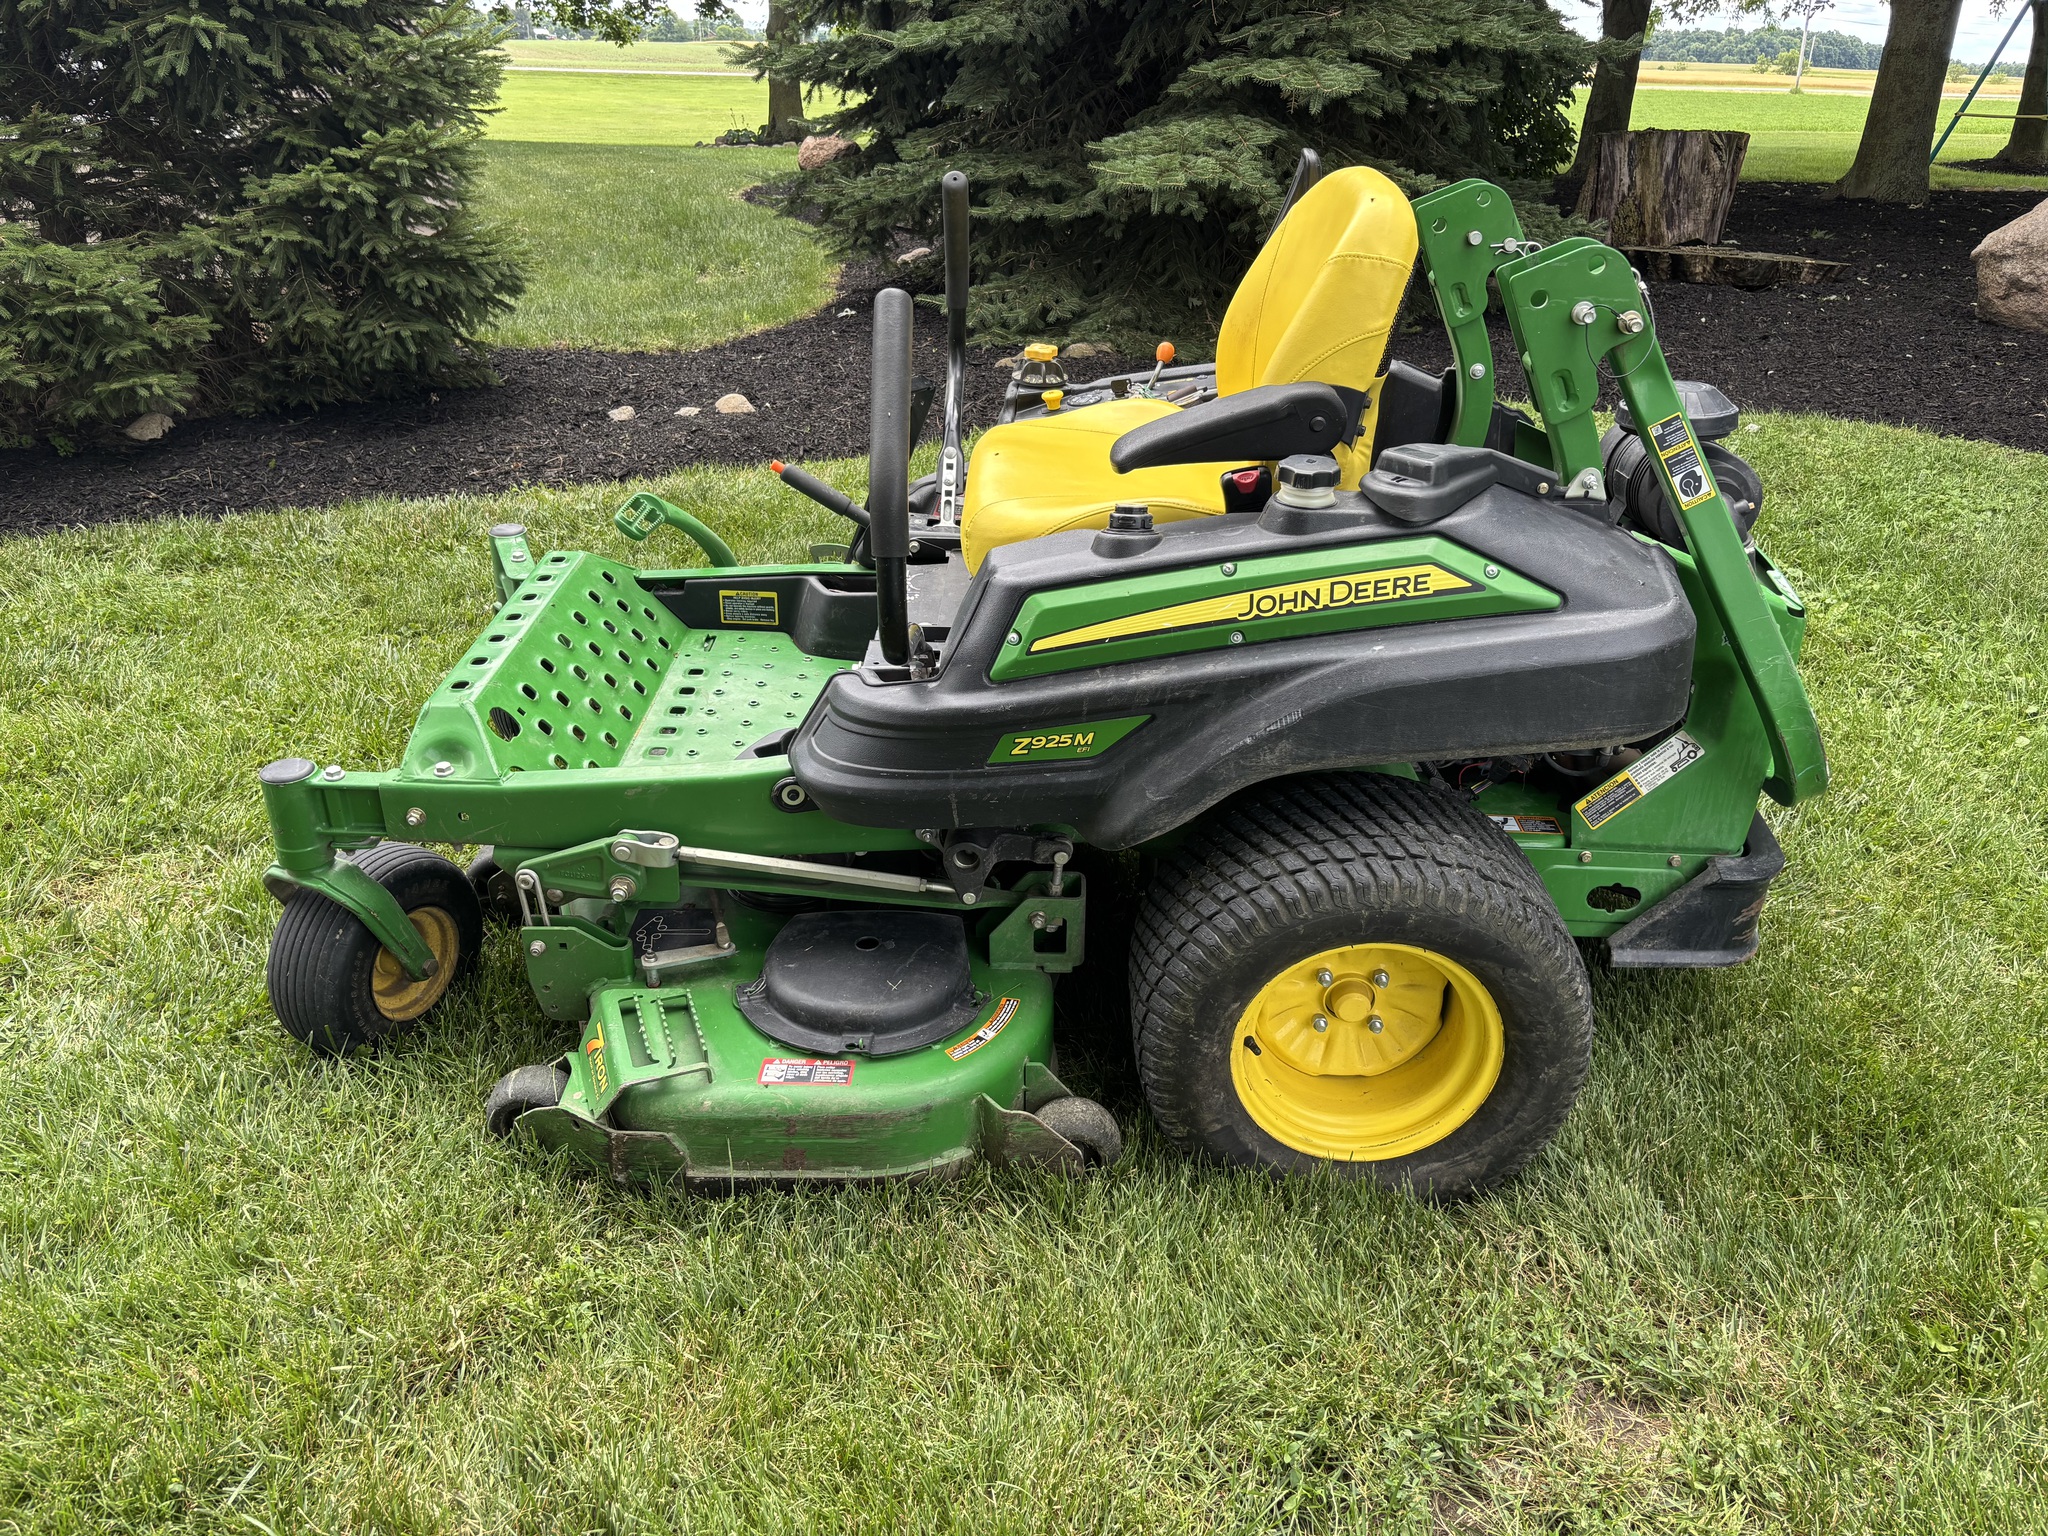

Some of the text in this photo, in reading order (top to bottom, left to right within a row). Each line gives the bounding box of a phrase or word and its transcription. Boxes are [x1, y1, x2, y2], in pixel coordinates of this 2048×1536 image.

[1237, 572, 1431, 618] JOHN DEERE
[593, 1048, 609, 1094] IRON
